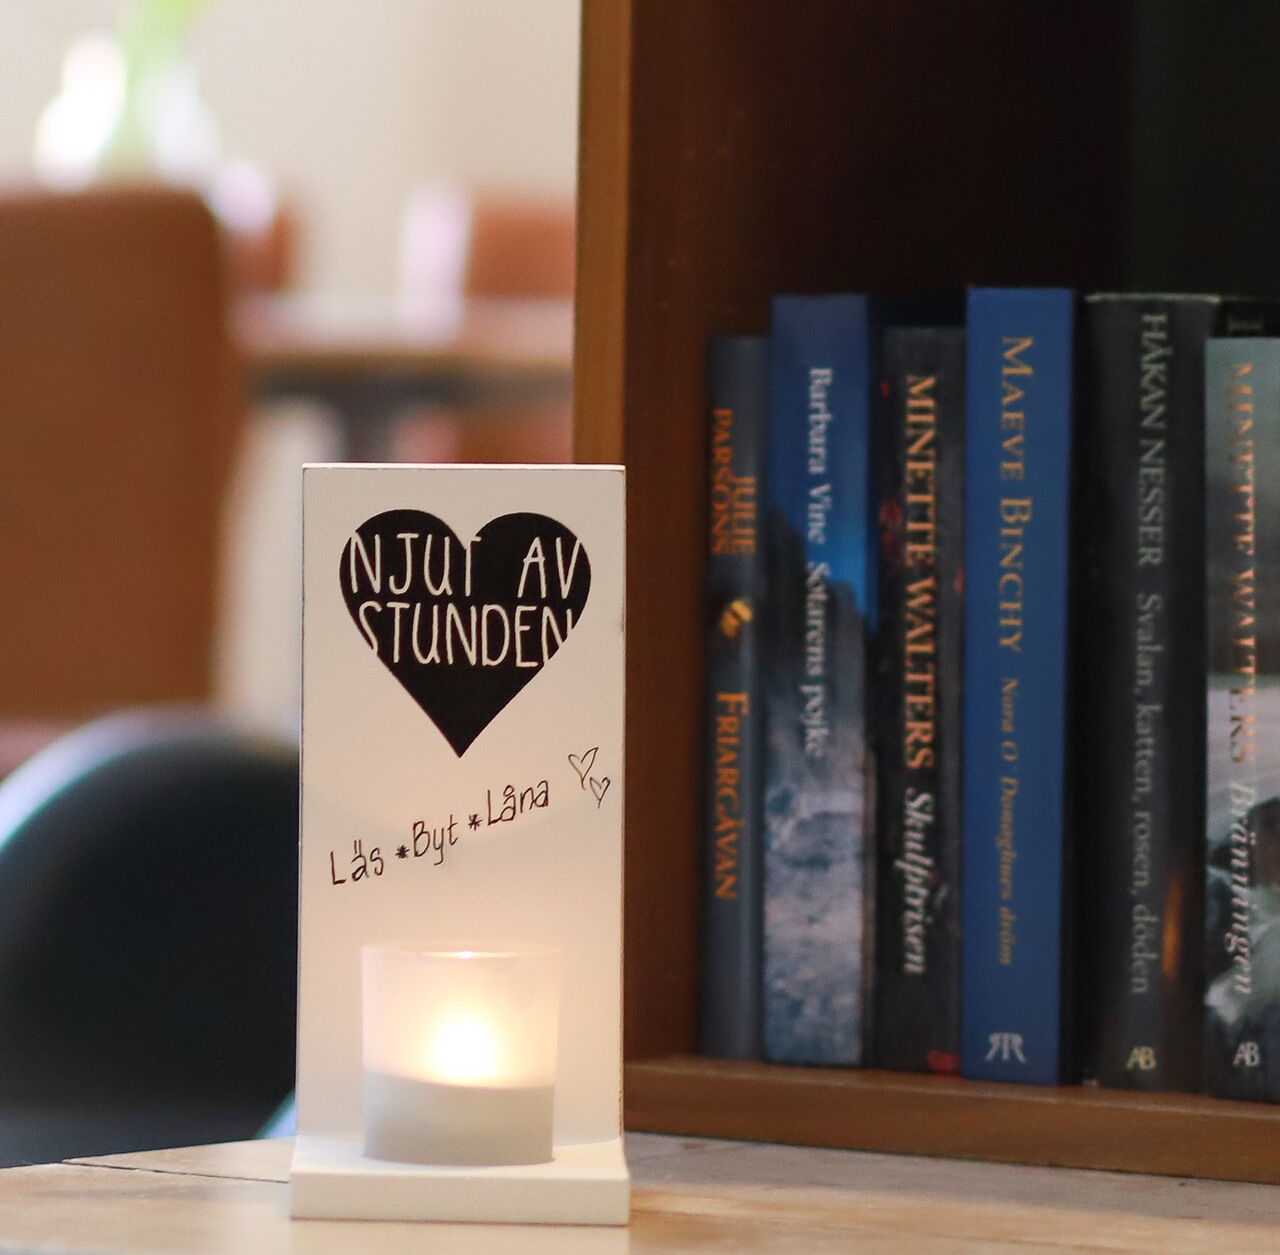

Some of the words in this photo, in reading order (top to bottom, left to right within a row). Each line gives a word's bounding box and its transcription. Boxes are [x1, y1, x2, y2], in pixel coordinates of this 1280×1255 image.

[807, 367, 835, 475] Barbara
[1000, 335, 1034, 482] MAEVE
[1138, 312, 1169, 430] HÅKAN
[806, 484, 831, 543] Vine
[904, 374, 936, 564] MINETTE
[1139, 439, 1166, 568] NESSER
[1228, 363, 1257, 555] MINETTE
[350, 531, 482, 597] NJUT
[521, 534, 583, 601] AV
[803, 560, 830, 676] Sotarens
[997, 497, 1032, 652] BINCHY
[357, 600, 576, 668] STUNDEN
[903, 575, 935, 770] WALTERS
[1130, 594, 1162, 695] Svalan,
[1228, 566, 1255, 763] WALTERS
[798, 684, 829, 758] pojke
[1000, 676, 1019, 734] Nora
[1130, 703, 1160, 800] katten,
[329, 839, 385, 887] Läs
[486, 778, 551, 827] Låna
[894, 787, 935, 974] Skulptrisen
[1222, 780, 1257, 997] Bränningen
[1131, 905, 1160, 994] döden
